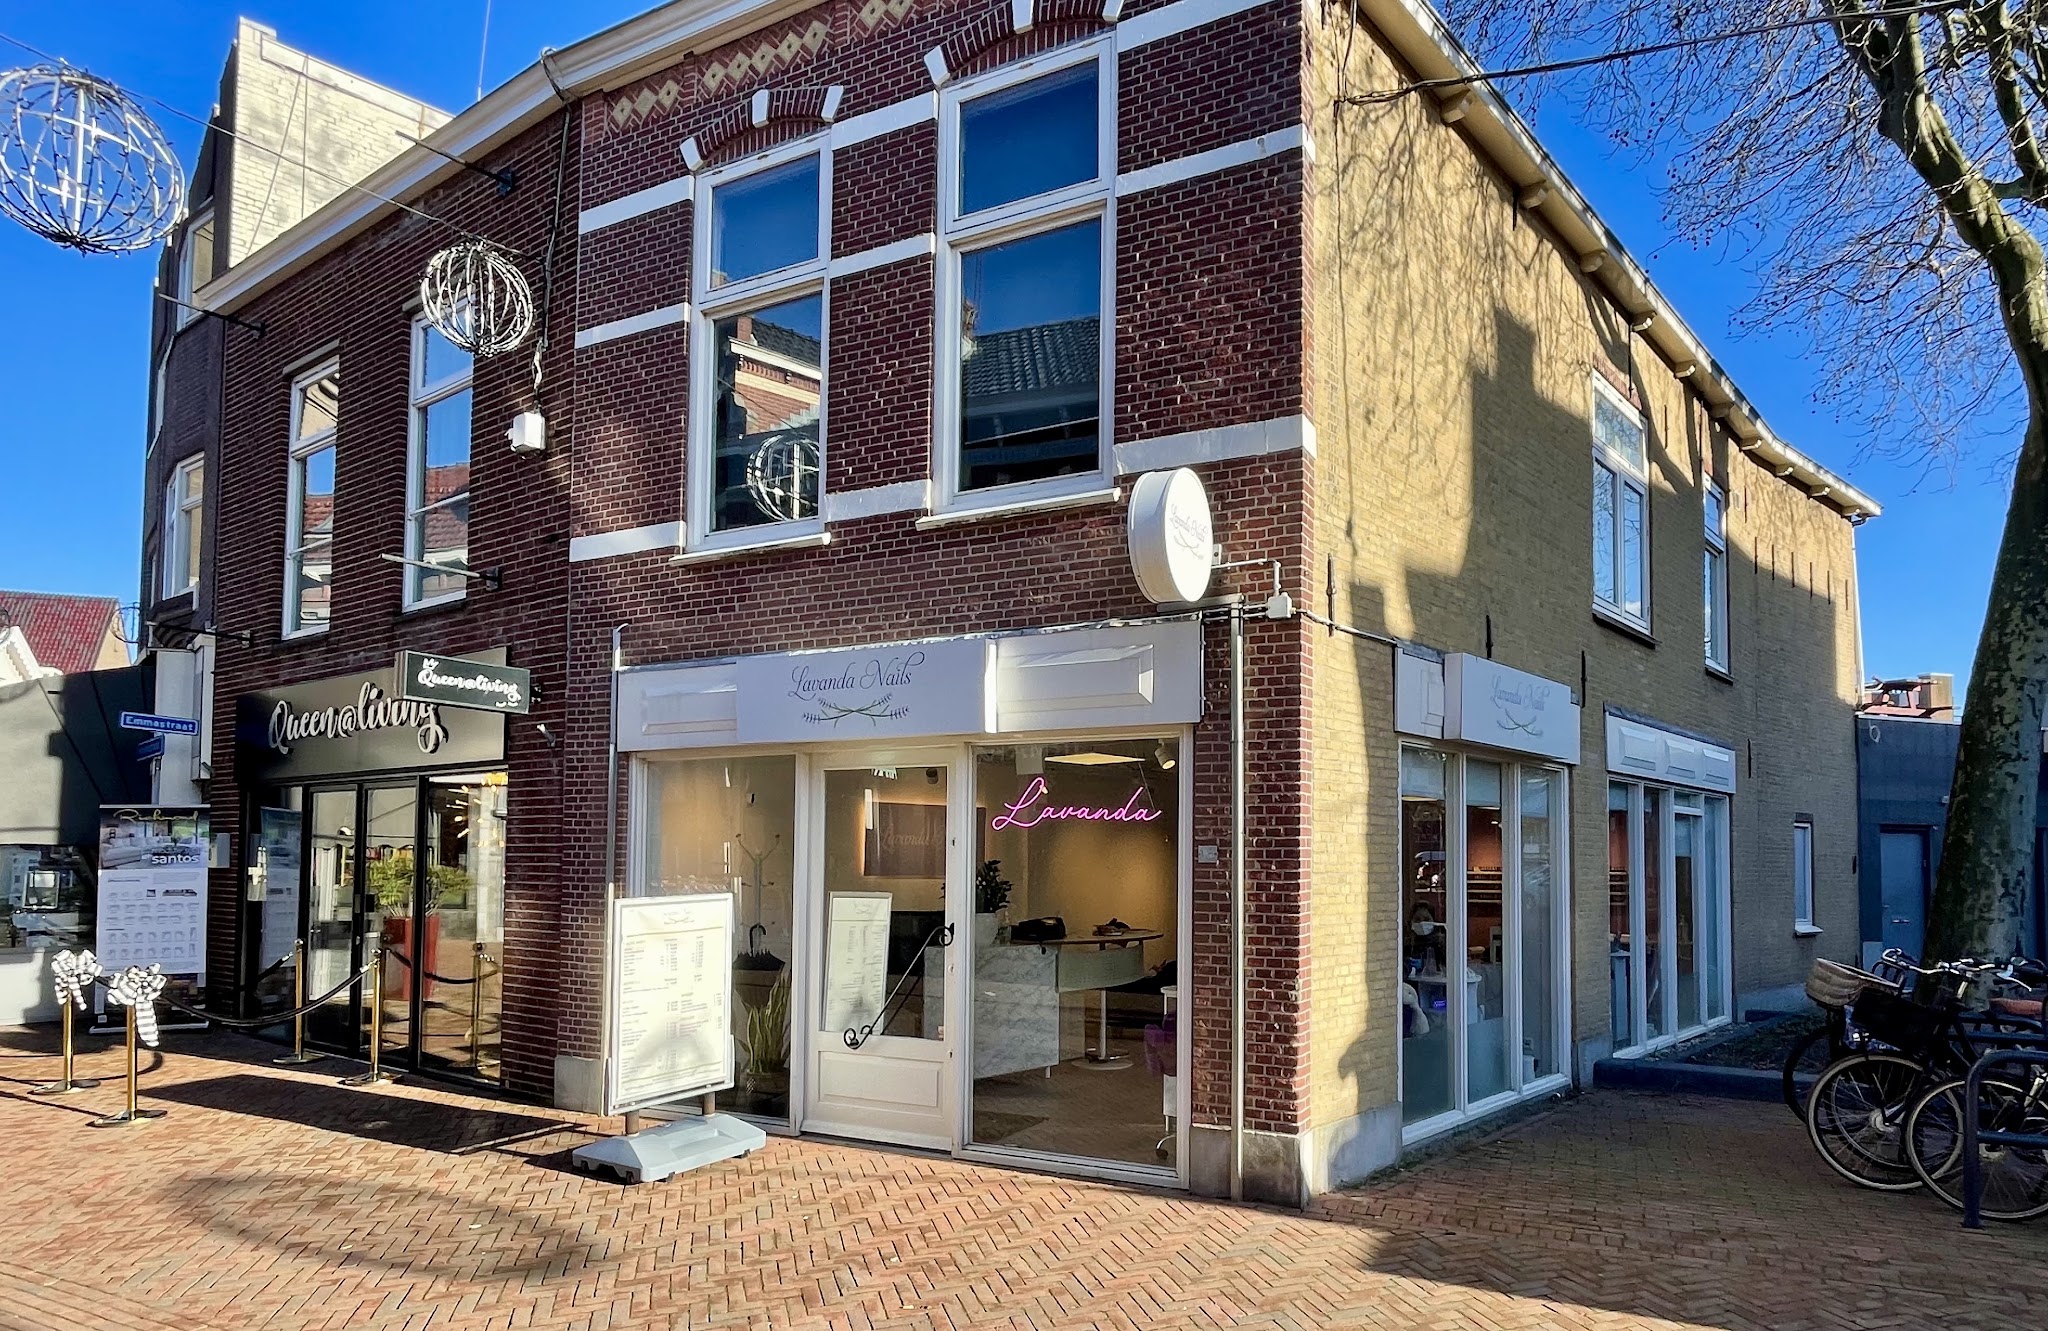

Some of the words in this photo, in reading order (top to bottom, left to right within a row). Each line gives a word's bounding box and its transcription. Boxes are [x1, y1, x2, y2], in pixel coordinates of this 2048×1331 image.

[417, 669, 522, 701] Queen@living
[787, 661, 856, 701] Lavanda
[859, 651, 925, 690] Nails
[125, 716, 194, 731] Emmastraat
[268, 681, 444, 755] Queen@living
[991, 776, 1163, 831] Lavanda
[151, 854, 200, 865] santos
